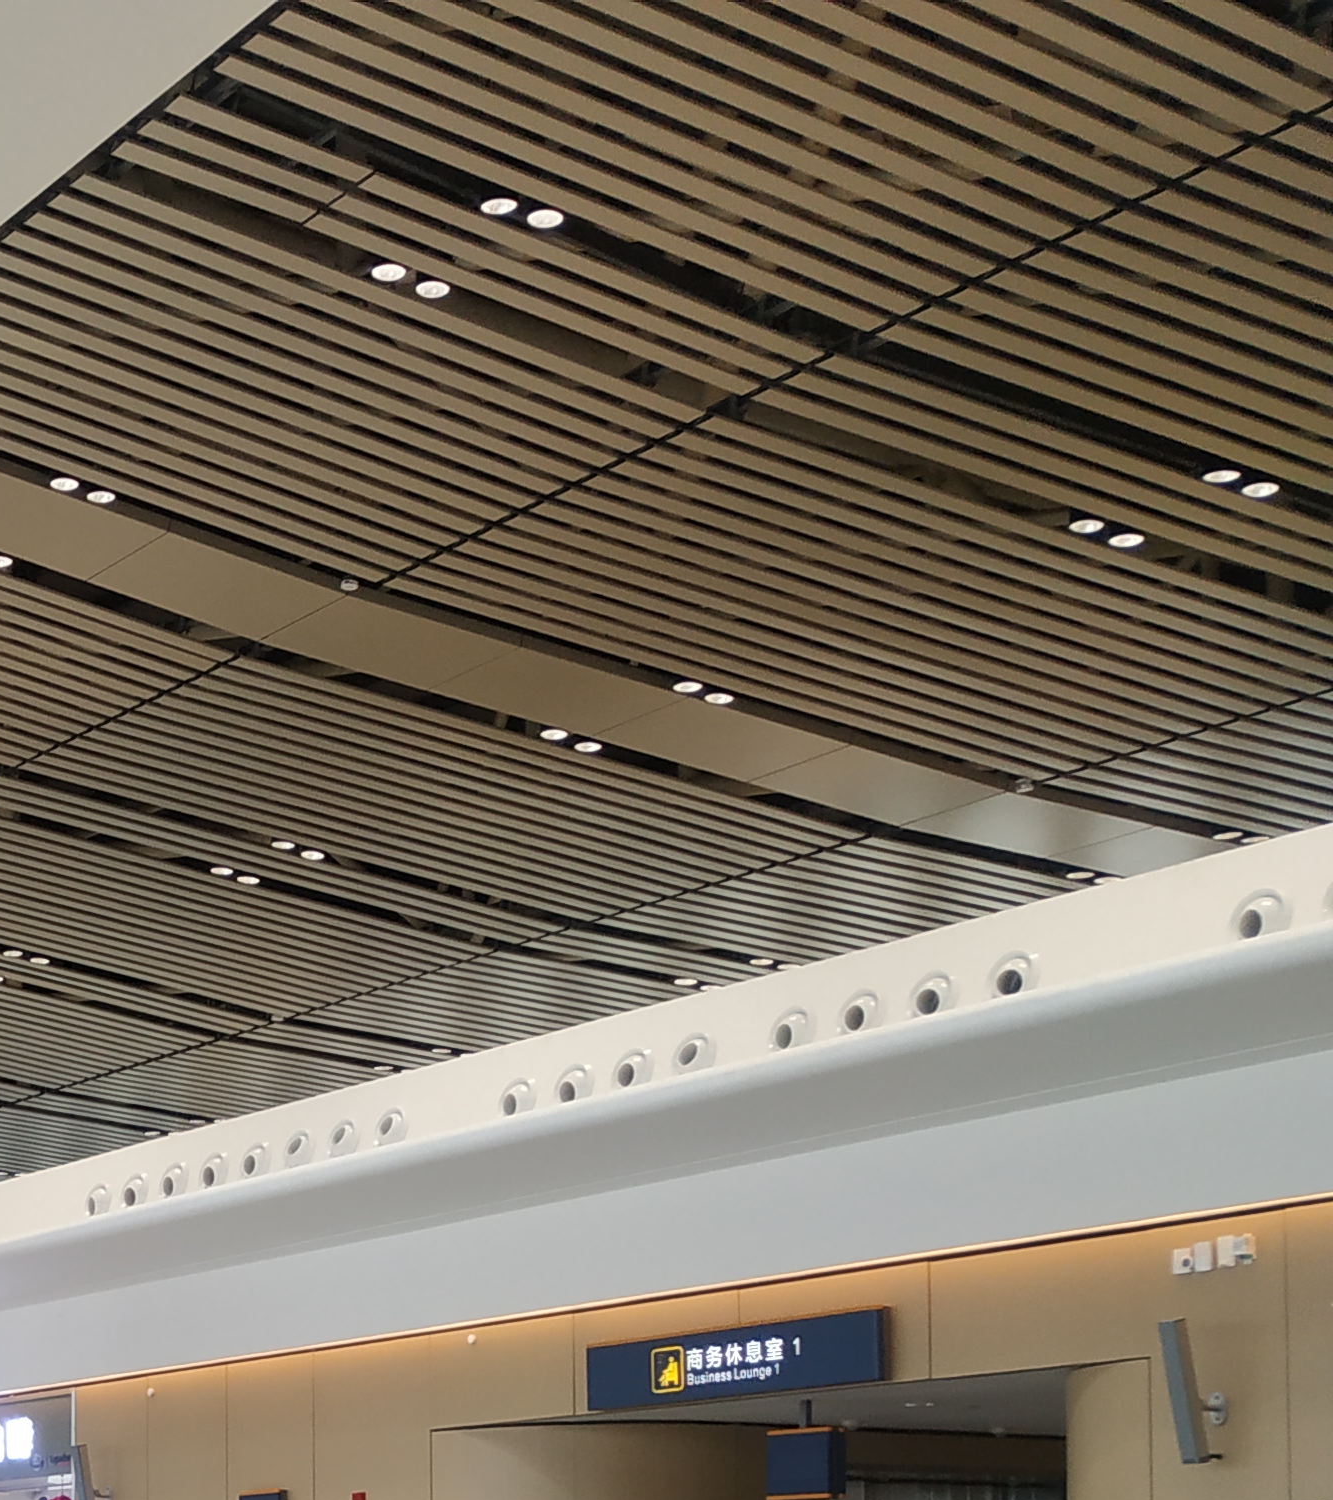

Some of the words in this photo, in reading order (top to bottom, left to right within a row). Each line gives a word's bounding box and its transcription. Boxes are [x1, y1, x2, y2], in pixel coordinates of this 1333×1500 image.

[686, 1337, 784, 1370] 商务休息室
[792, 1337, 801, 1356] 1
[687, 1371, 732, 1386] Business
[734, 1364, 772, 1381] Lounge
[774, 1363, 780, 1375] 1
